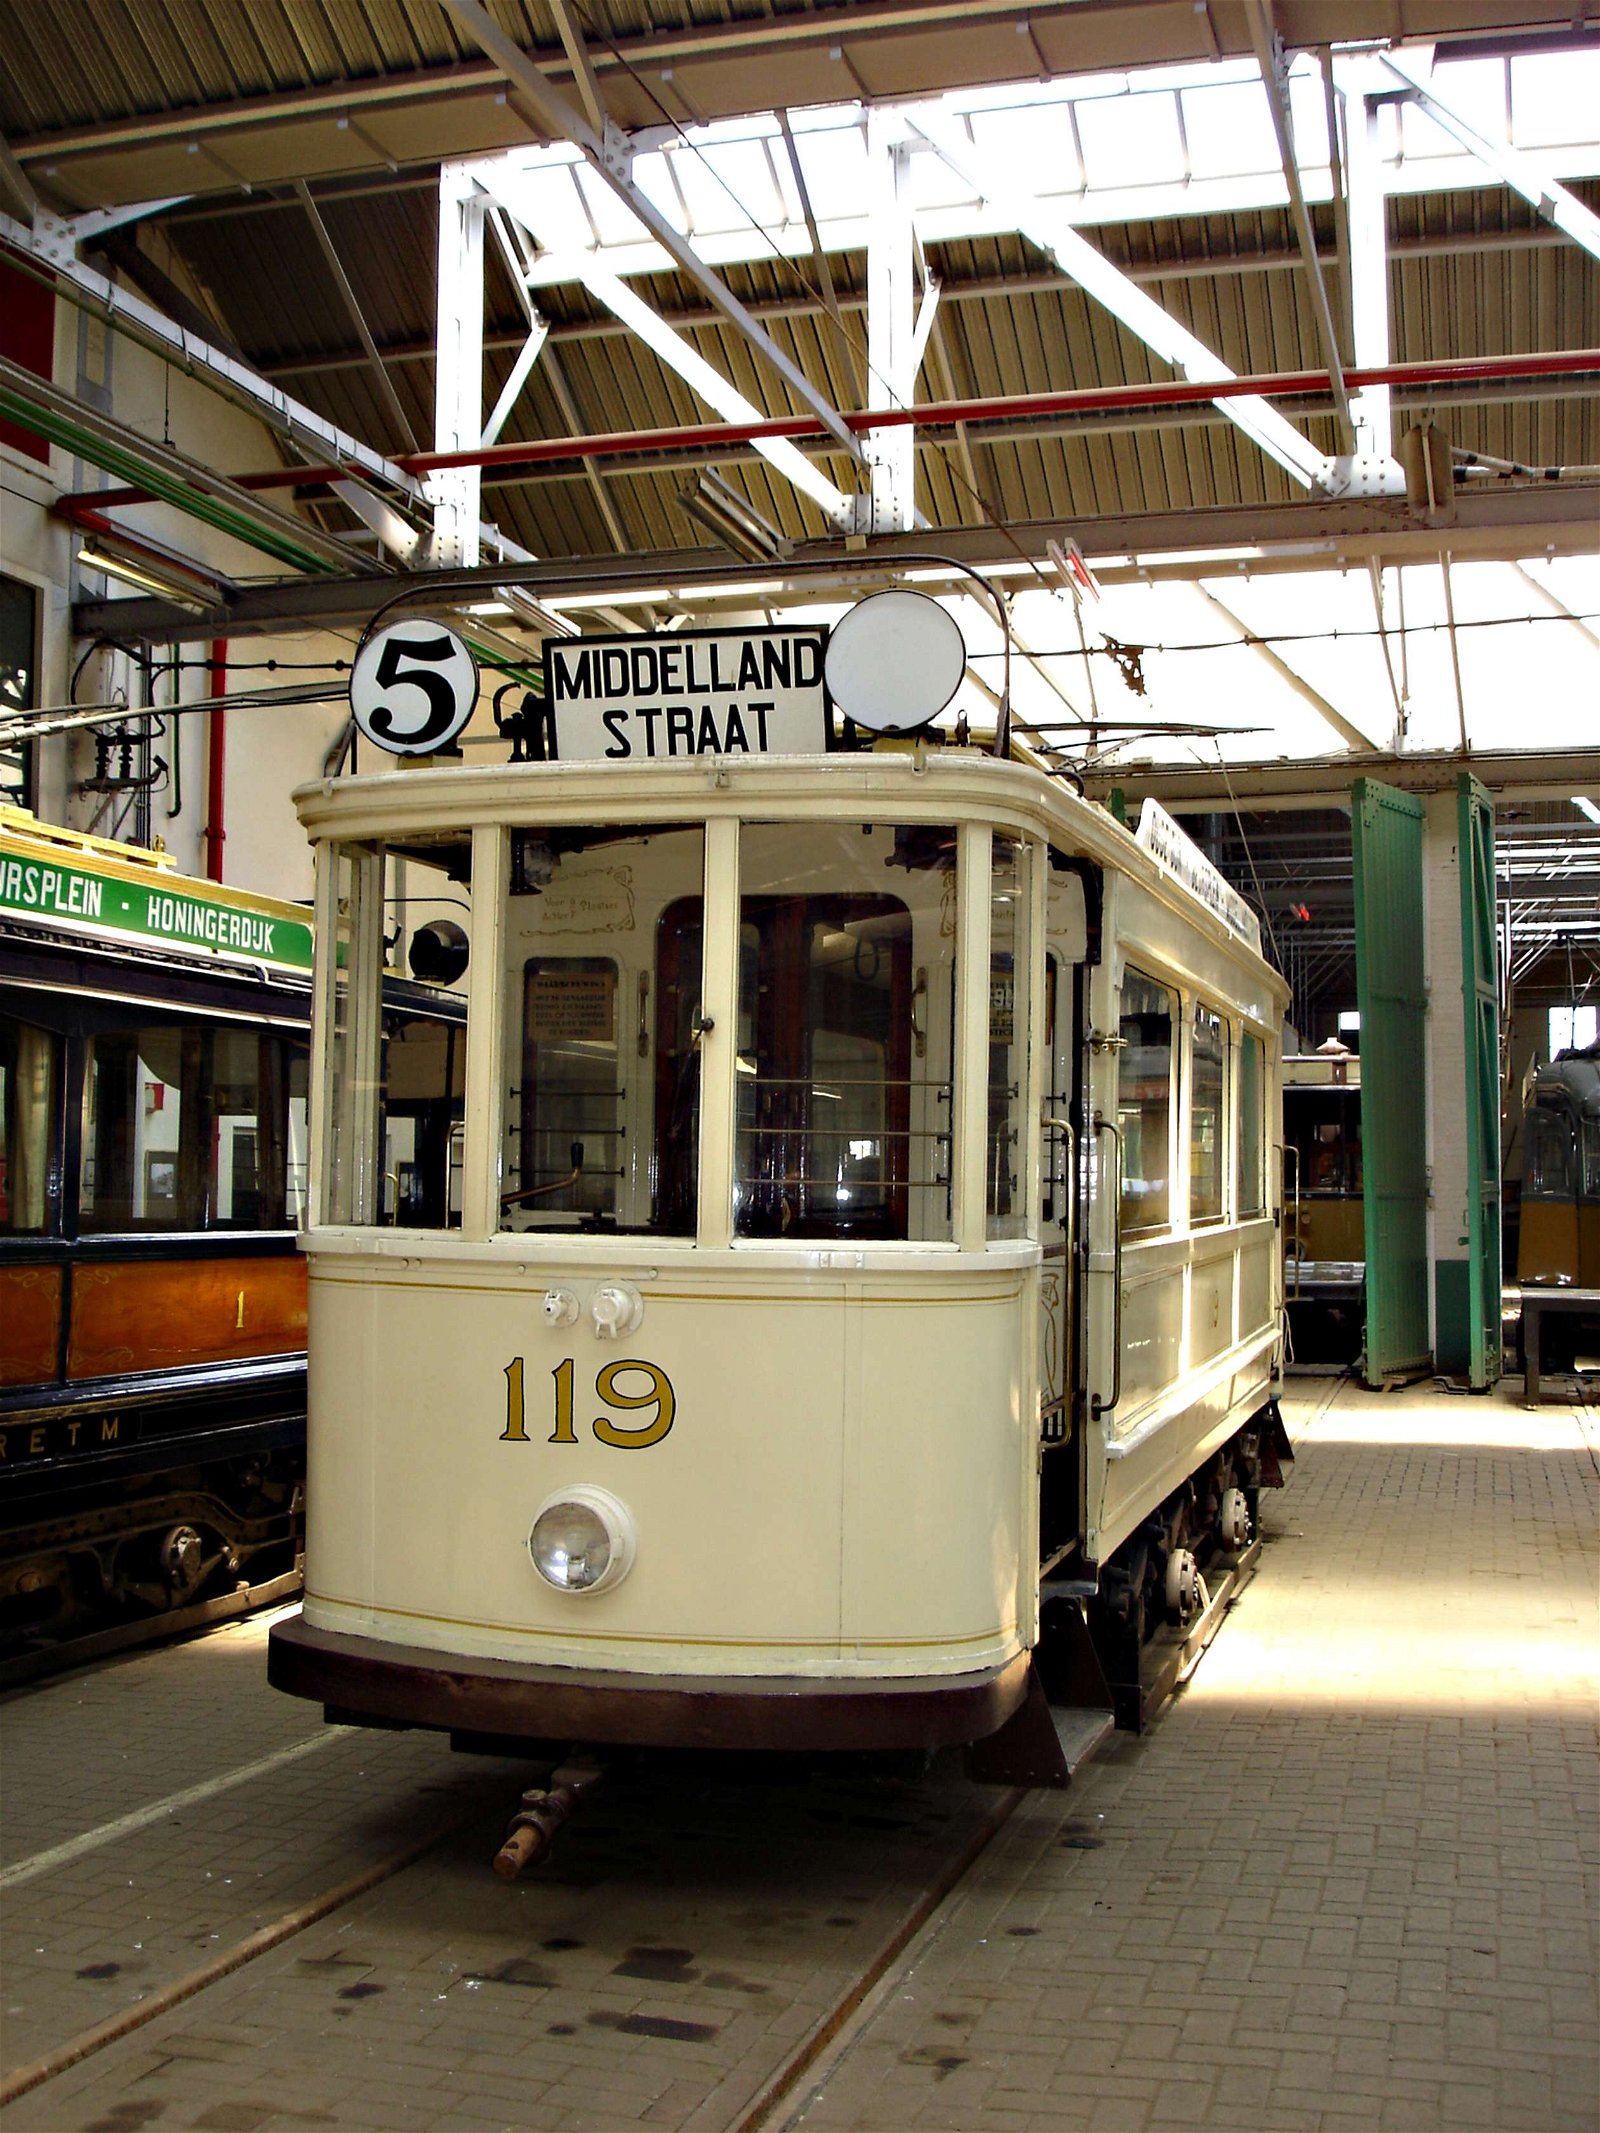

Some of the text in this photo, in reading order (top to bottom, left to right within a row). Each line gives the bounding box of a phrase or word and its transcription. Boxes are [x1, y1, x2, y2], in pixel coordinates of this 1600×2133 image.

[369, 635, 457, 745] 5
[553, 637, 822, 701] MIDDELLAND
[602, 702, 775, 759] STRAAT
[235, 1290, 245, 1328] 1
[499, 1356, 677, 1450] 119
